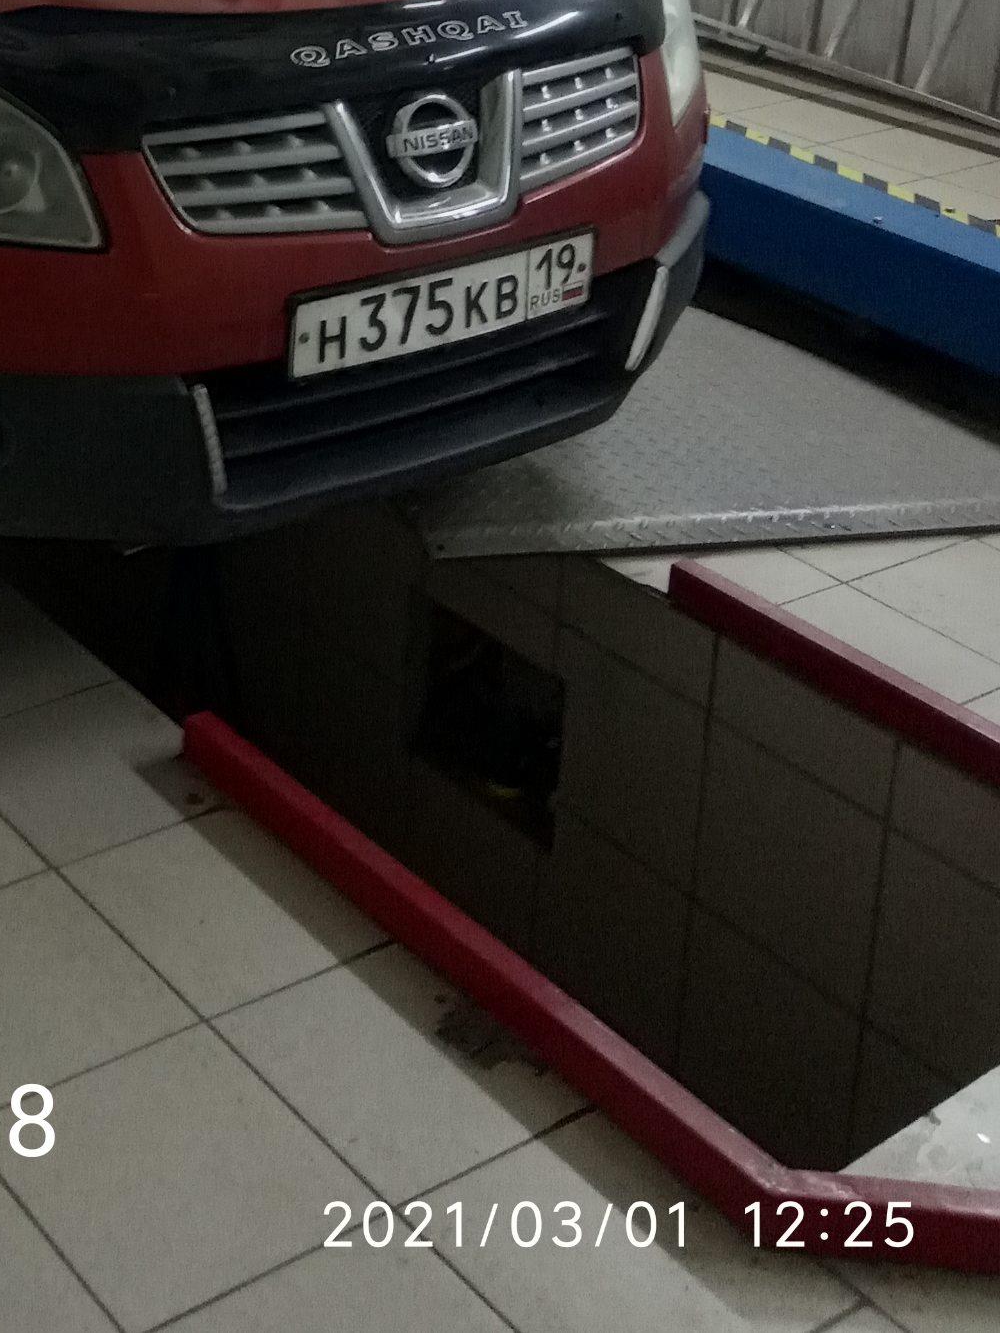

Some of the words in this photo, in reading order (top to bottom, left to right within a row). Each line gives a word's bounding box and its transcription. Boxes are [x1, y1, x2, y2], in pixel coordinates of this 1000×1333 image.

[289, 10, 529, 68] QASHQAI
[402, 126, 475, 153] NISSAN
[534, 243, 576, 290] 19
[529, 290, 562, 312] RUS
